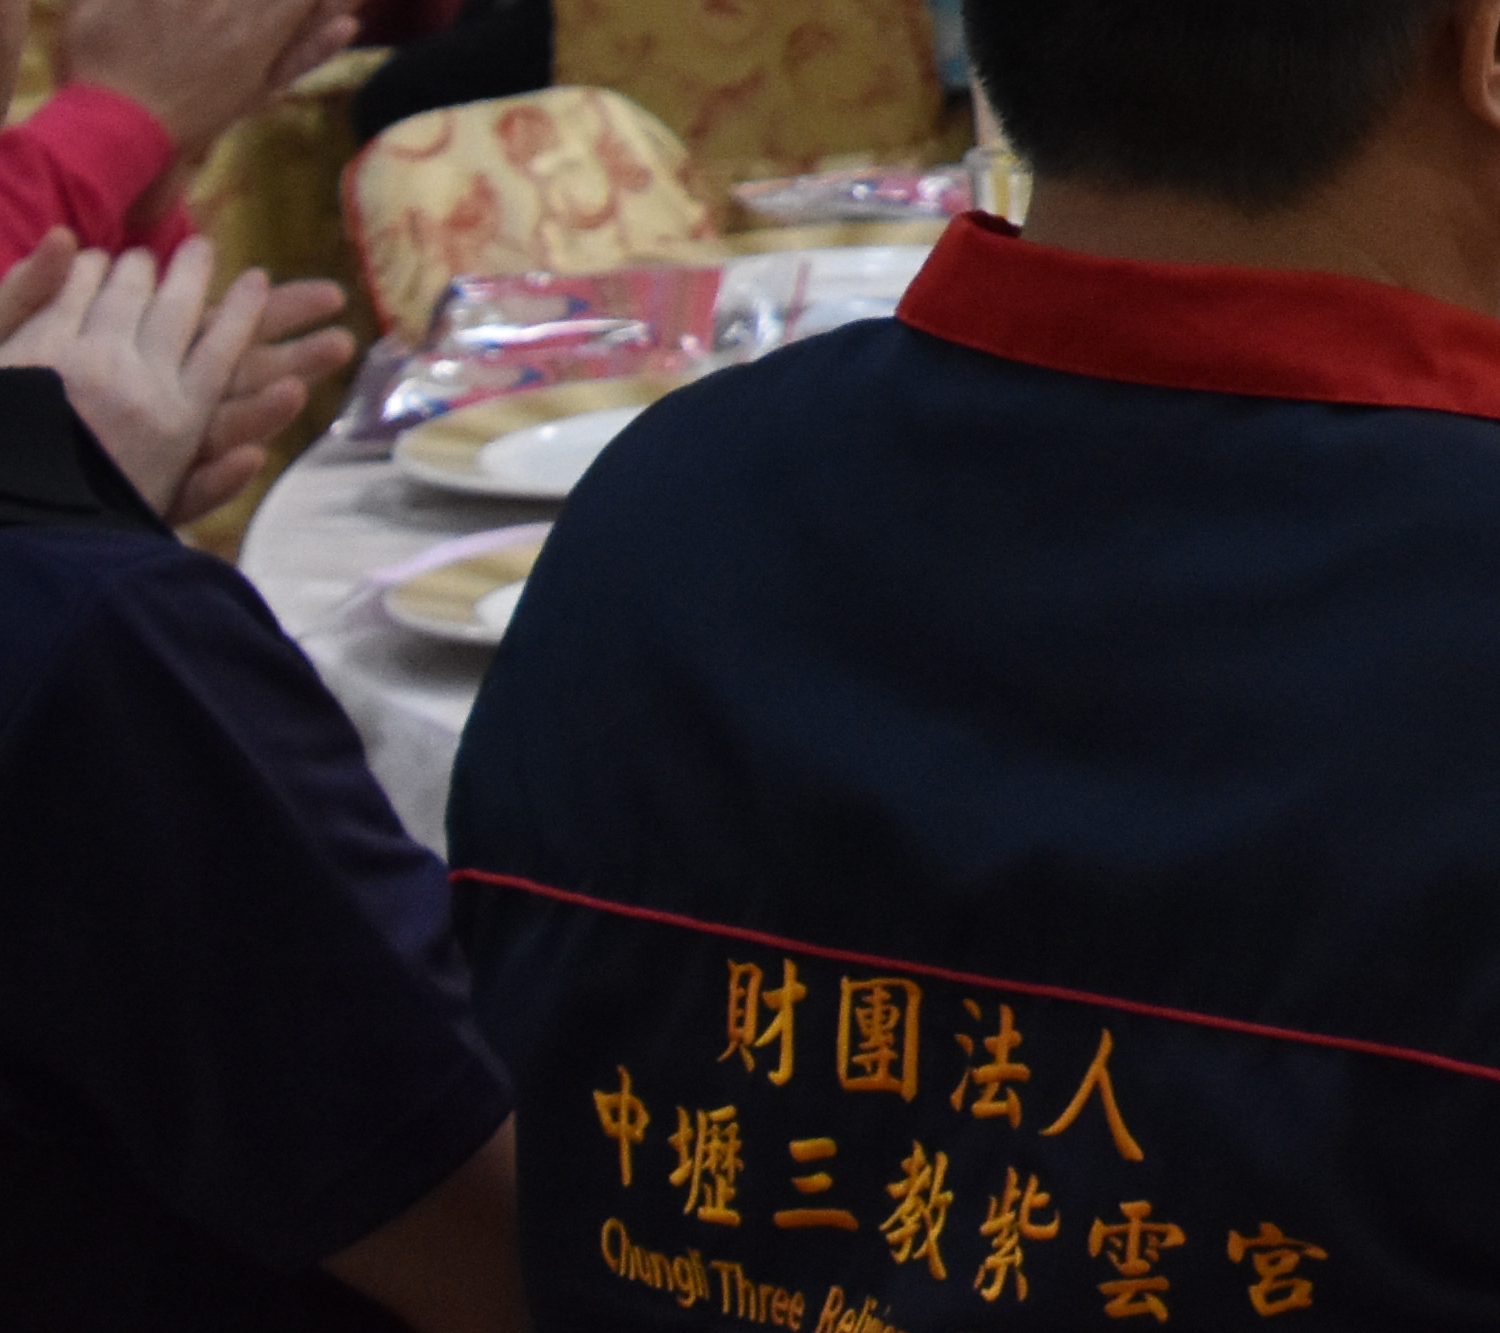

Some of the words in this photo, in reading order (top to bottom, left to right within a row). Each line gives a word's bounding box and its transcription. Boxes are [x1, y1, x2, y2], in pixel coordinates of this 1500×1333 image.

[718, 958, 1143, 1161] 財團法人
[592, 1063, 1330, 1321] 中壢三教紫雲宮
[601, 1218, 710, 1308] Chungli
[710, 1261, 805, 1331] Three
